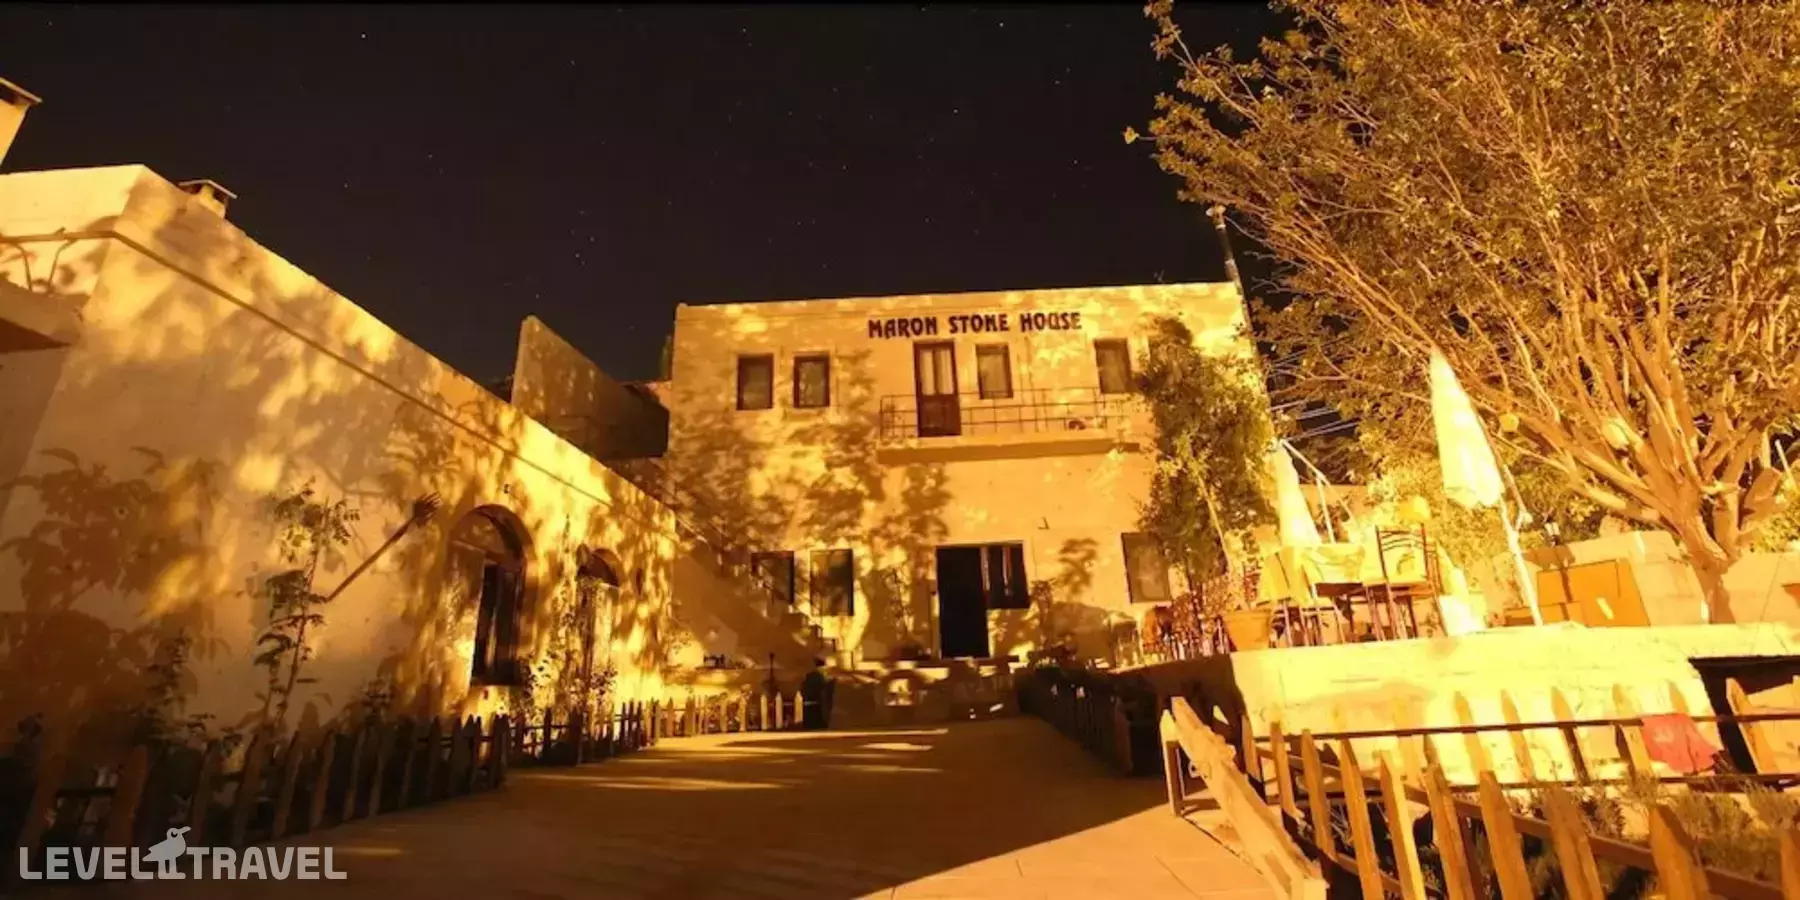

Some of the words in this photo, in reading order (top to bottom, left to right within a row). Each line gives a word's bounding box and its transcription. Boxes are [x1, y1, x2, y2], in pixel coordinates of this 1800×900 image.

[868, 316, 938, 339] MARON
[948, 313, 1010, 334] STONE
[1019, 311, 1082, 332] HOUSE
